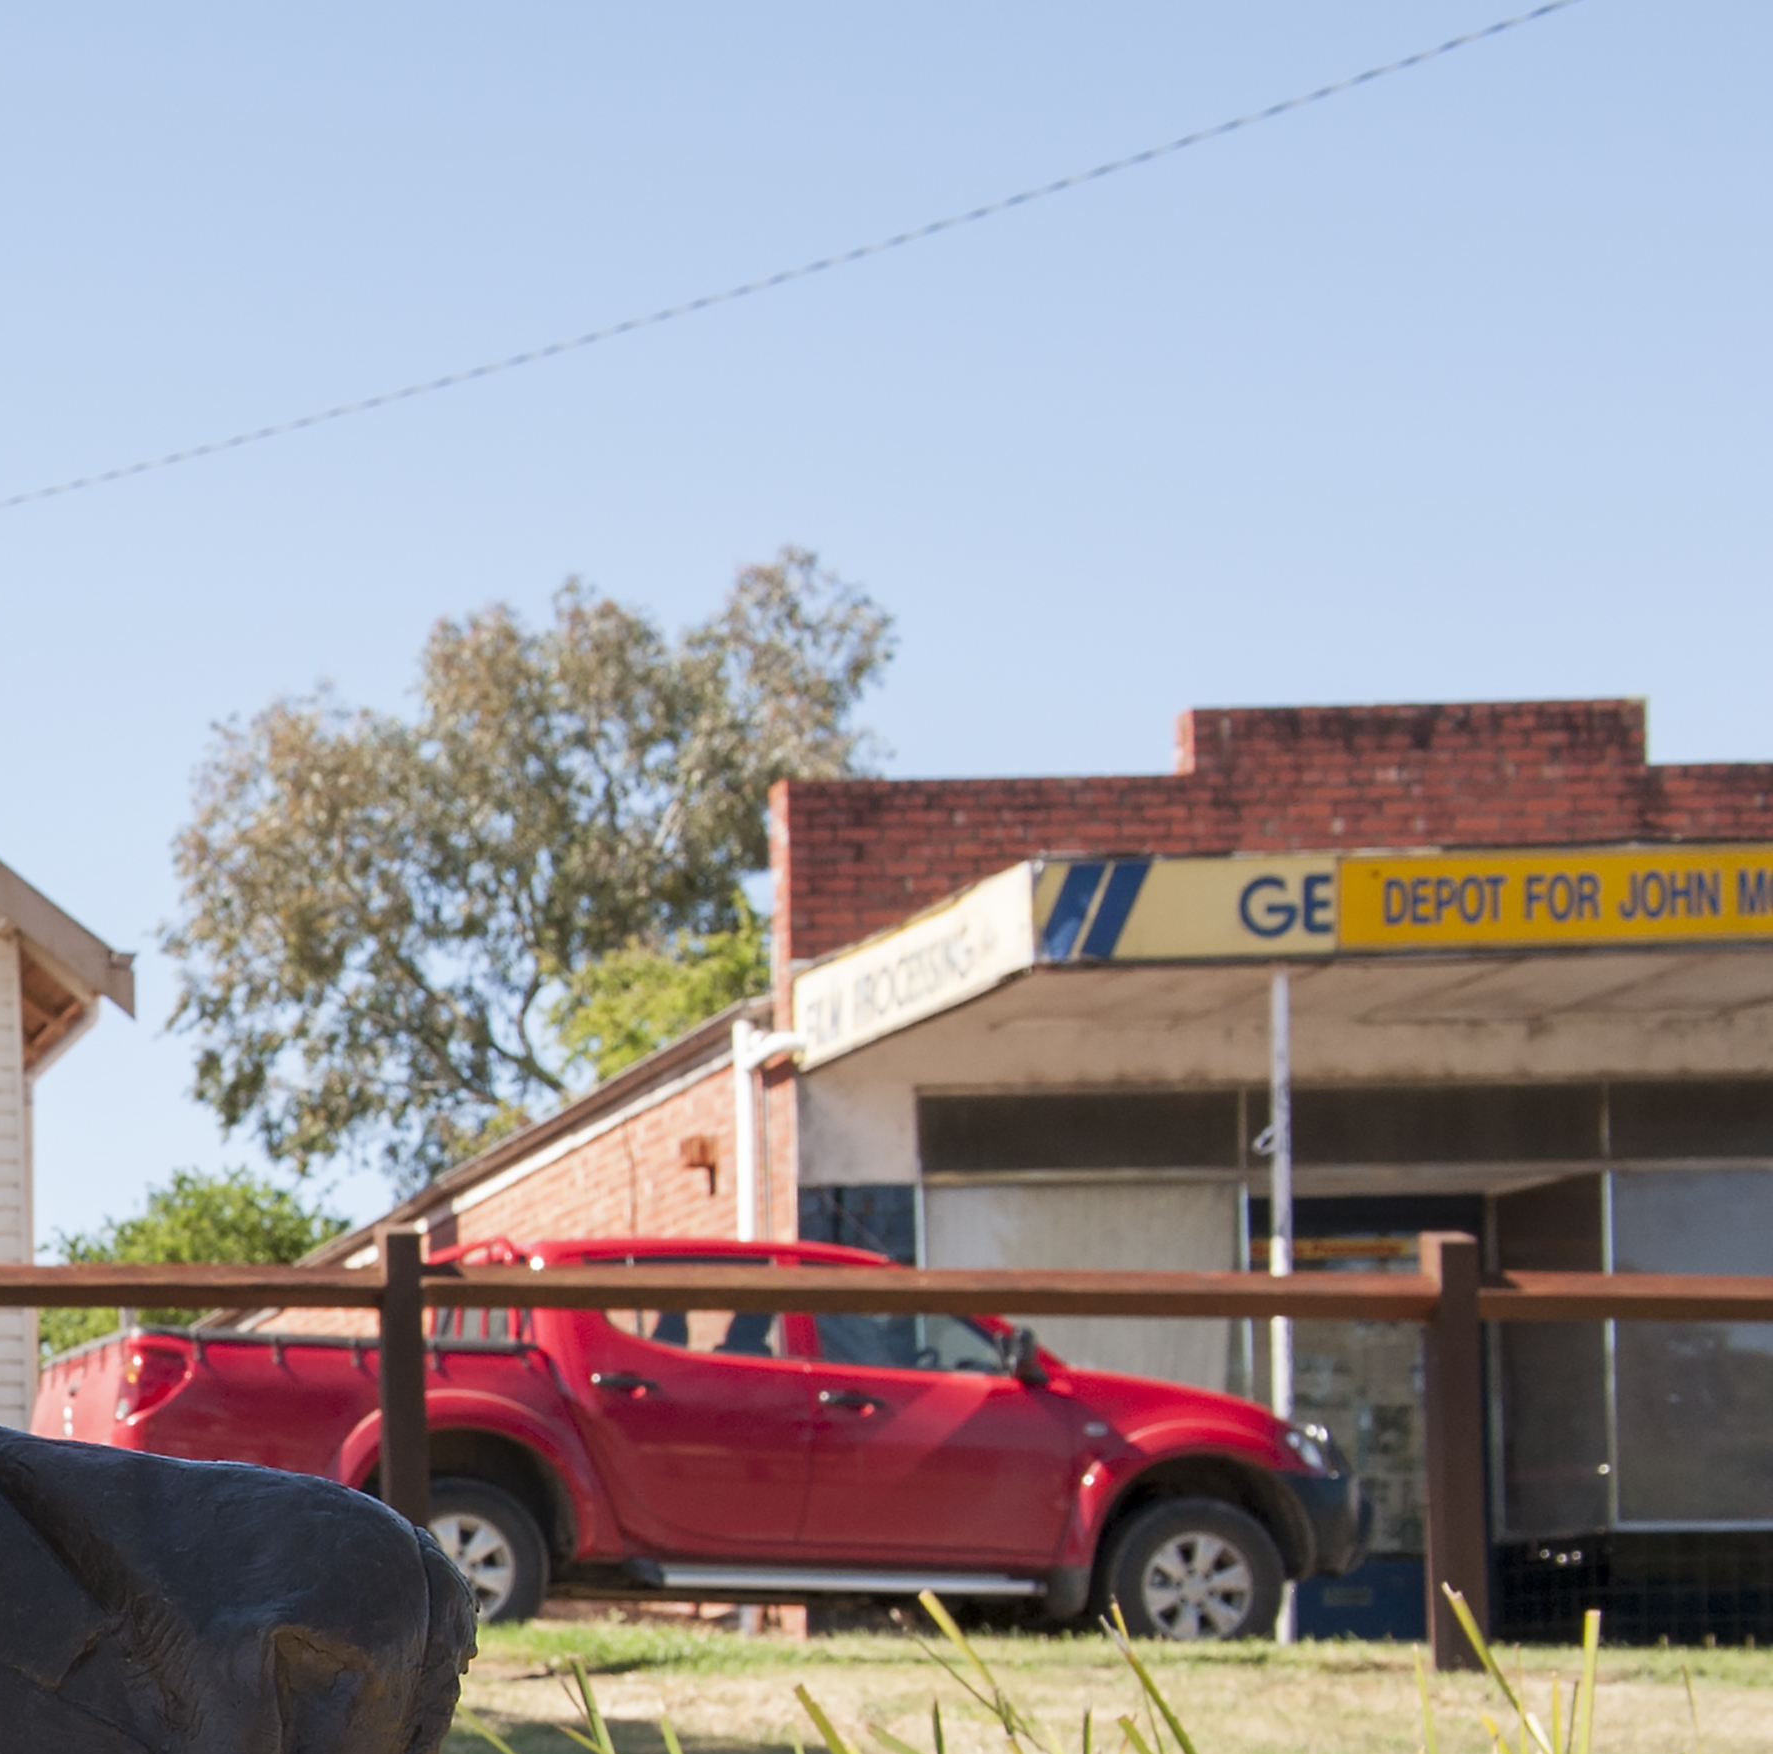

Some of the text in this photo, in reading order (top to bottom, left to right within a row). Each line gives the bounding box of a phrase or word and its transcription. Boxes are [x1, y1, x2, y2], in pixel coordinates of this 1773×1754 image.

[1383, 867, 1773, 925] DEPOT FOR JOHN M
